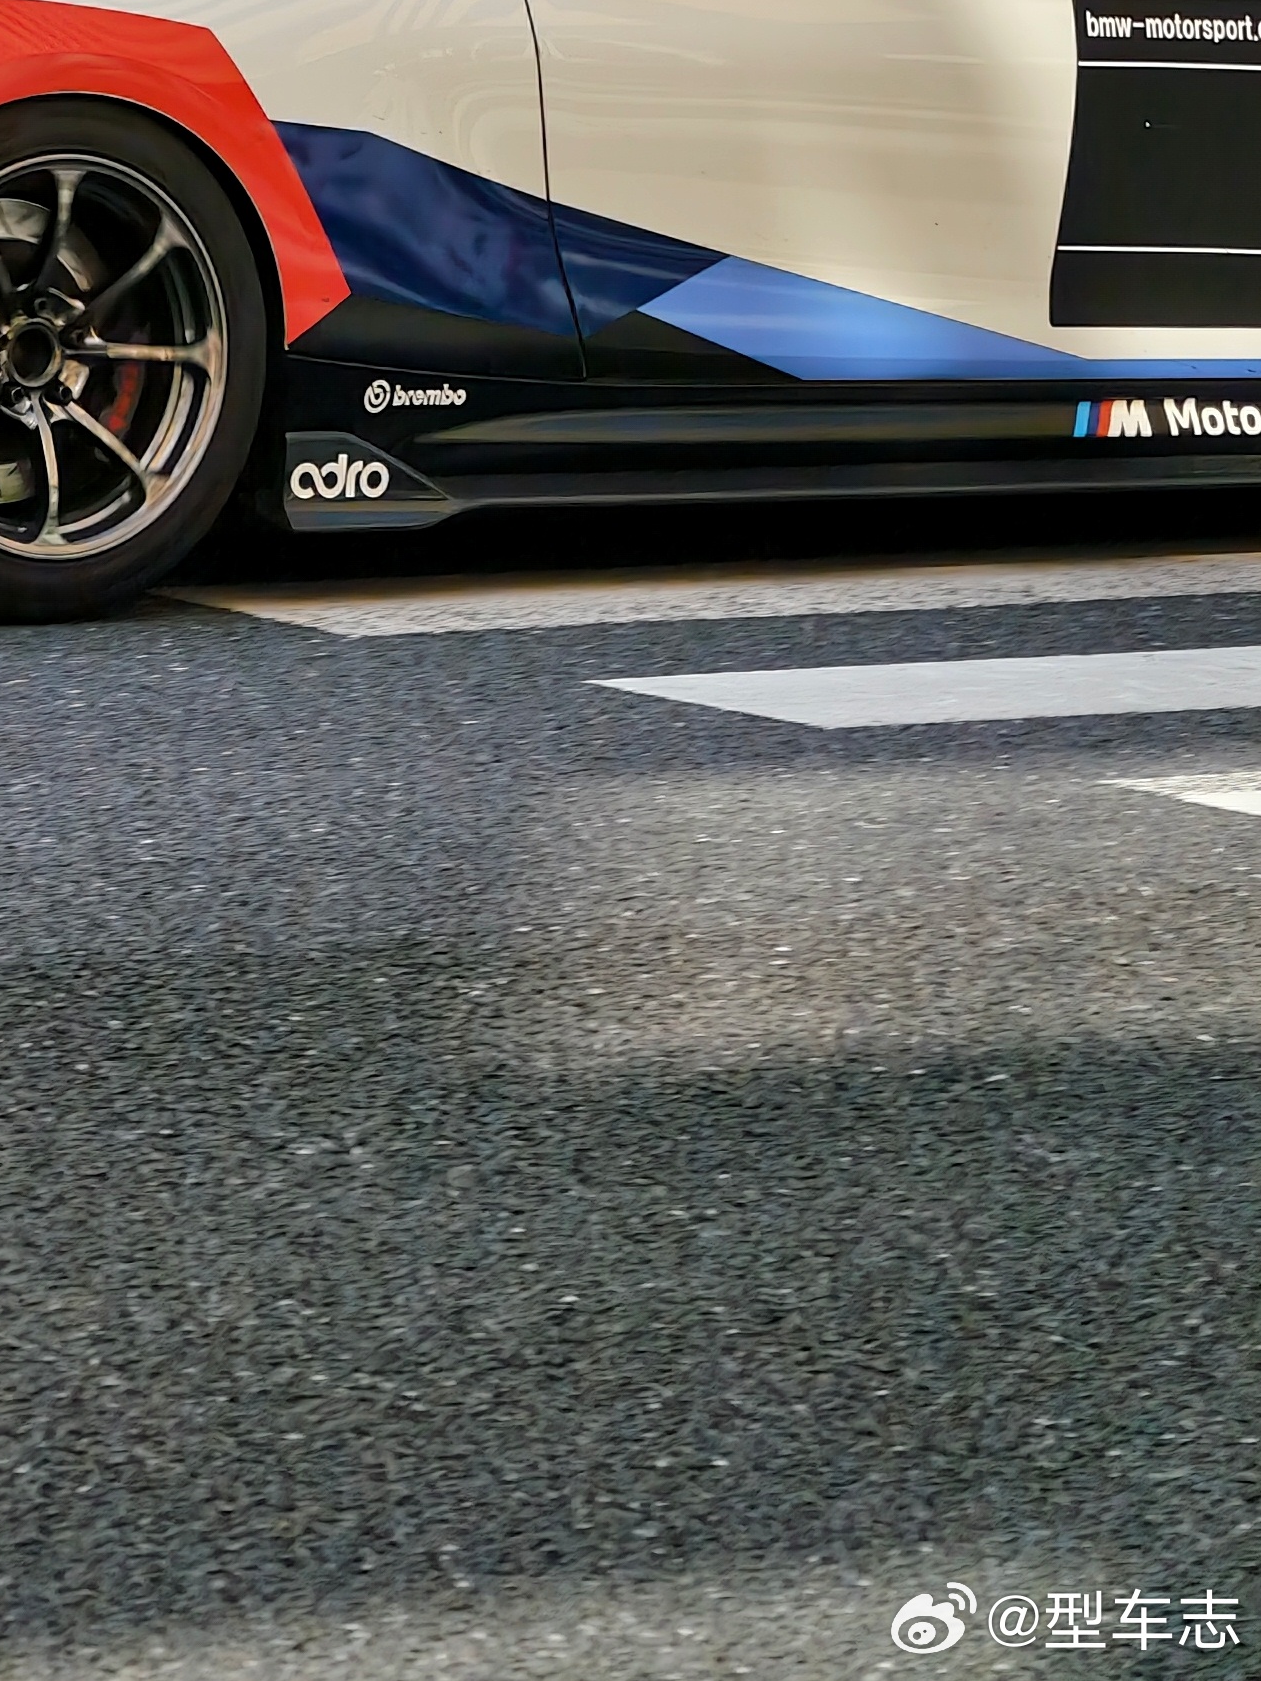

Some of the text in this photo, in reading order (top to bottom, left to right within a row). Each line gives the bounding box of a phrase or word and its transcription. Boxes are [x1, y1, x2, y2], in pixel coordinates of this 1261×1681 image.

[1085, 9, 1261, 44] bmw-motorsport.
[392, 383, 468, 407] brembo
[289, 453, 390, 500] adro
